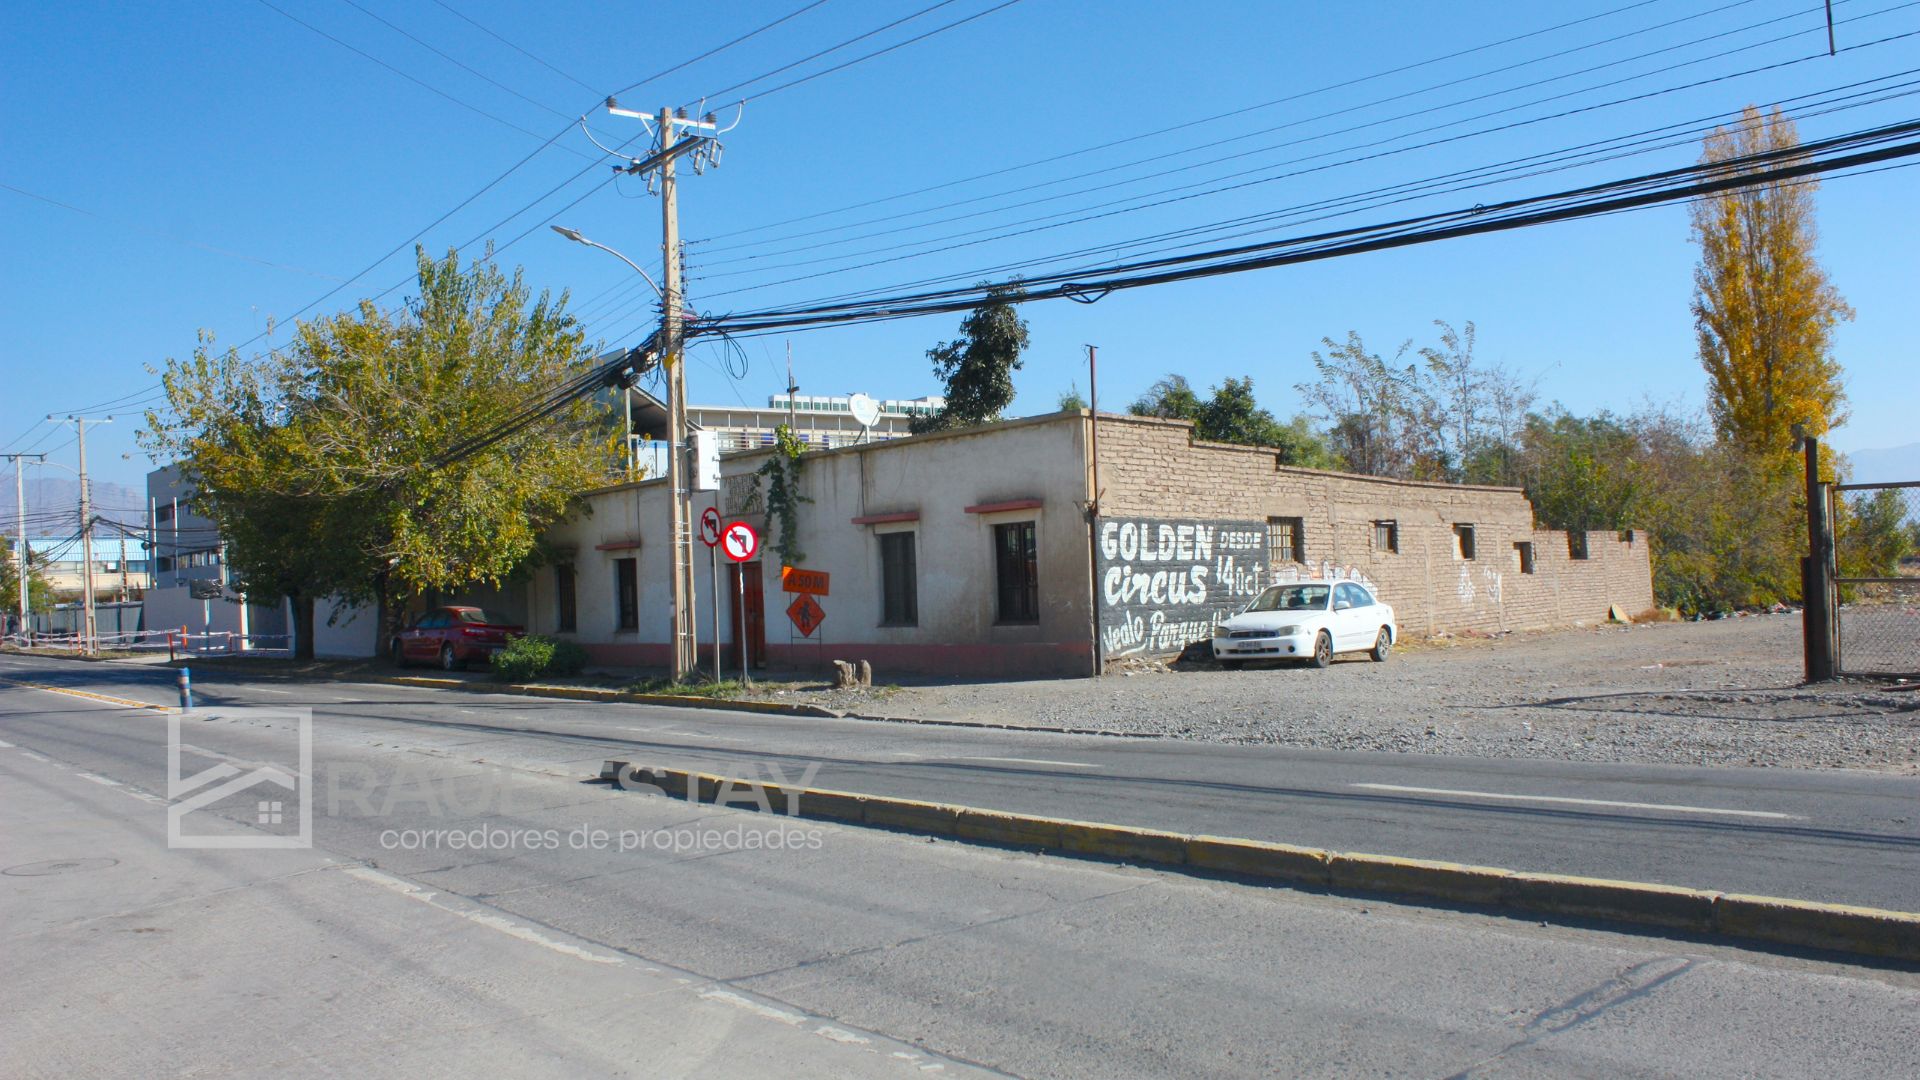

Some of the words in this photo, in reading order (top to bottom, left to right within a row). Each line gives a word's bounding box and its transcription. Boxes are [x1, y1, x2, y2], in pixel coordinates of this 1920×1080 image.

[1101, 521, 1214, 561] GOLDEN
[1219, 531, 1262, 549] DESDE
[1216, 555, 1235, 596] 14
